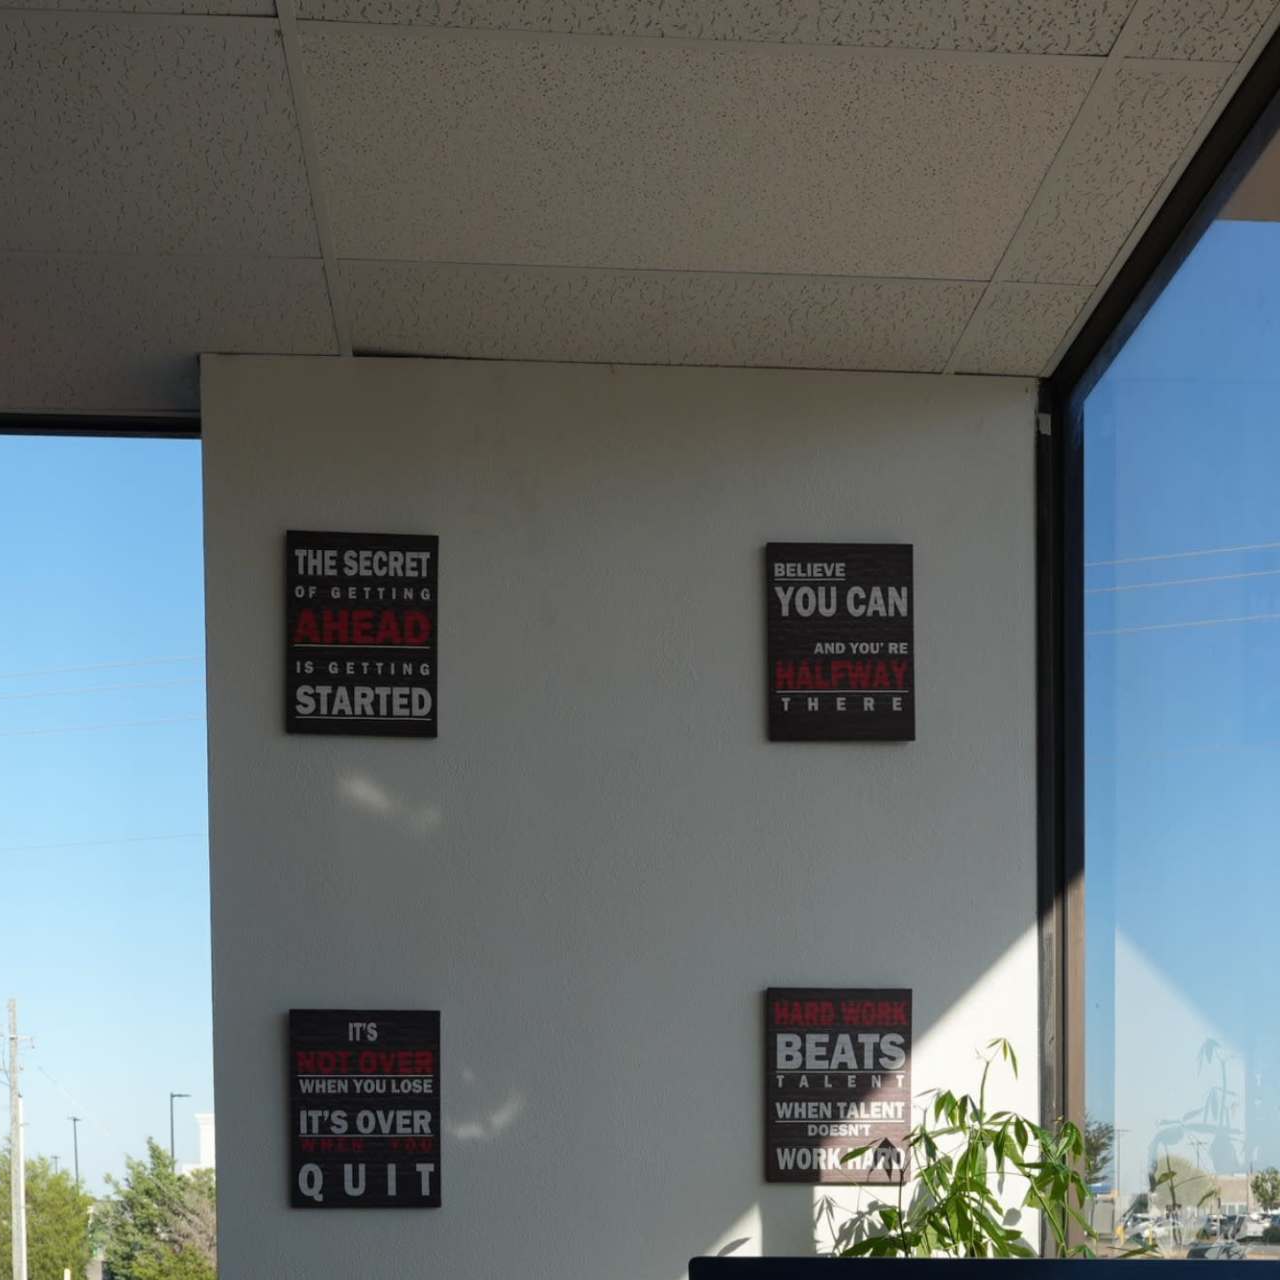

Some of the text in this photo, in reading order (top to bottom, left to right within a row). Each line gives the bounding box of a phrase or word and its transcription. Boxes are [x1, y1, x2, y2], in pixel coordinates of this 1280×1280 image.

[295, 549, 431, 577] THE SECRET
[774, 562, 846, 577] BELIEVE
[295, 585, 431, 600] OF GETTING
[774, 586, 908, 617] YOU CAN
[295, 608, 432, 645] AHEAD
[814, 642, 845, 654] AND
[296, 661, 431, 676] IS GETTING
[775, 661, 908, 689] HALFWAY
[295, 684, 433, 717] STARTED
[781, 697, 902, 711] THERE
[774, 1001, 907, 1025] HARD WORK
[348, 1022, 378, 1042] IT'S
[296, 1051, 433, 1073] NOT OVER
[776, 1033, 906, 1070] BEATS
[299, 1079, 433, 1094] WHEN YOU LOSE
[776, 1074, 905, 1088] TALENT
[776, 1102, 905, 1119] WHEN TALENT
[299, 1110, 432, 1135] IT'S OVER
[808, 1124, 871, 1137] DOESN'T
[777, 1148, 842, 1170] WORK
[298, 1163, 435, 1202] QUIT
